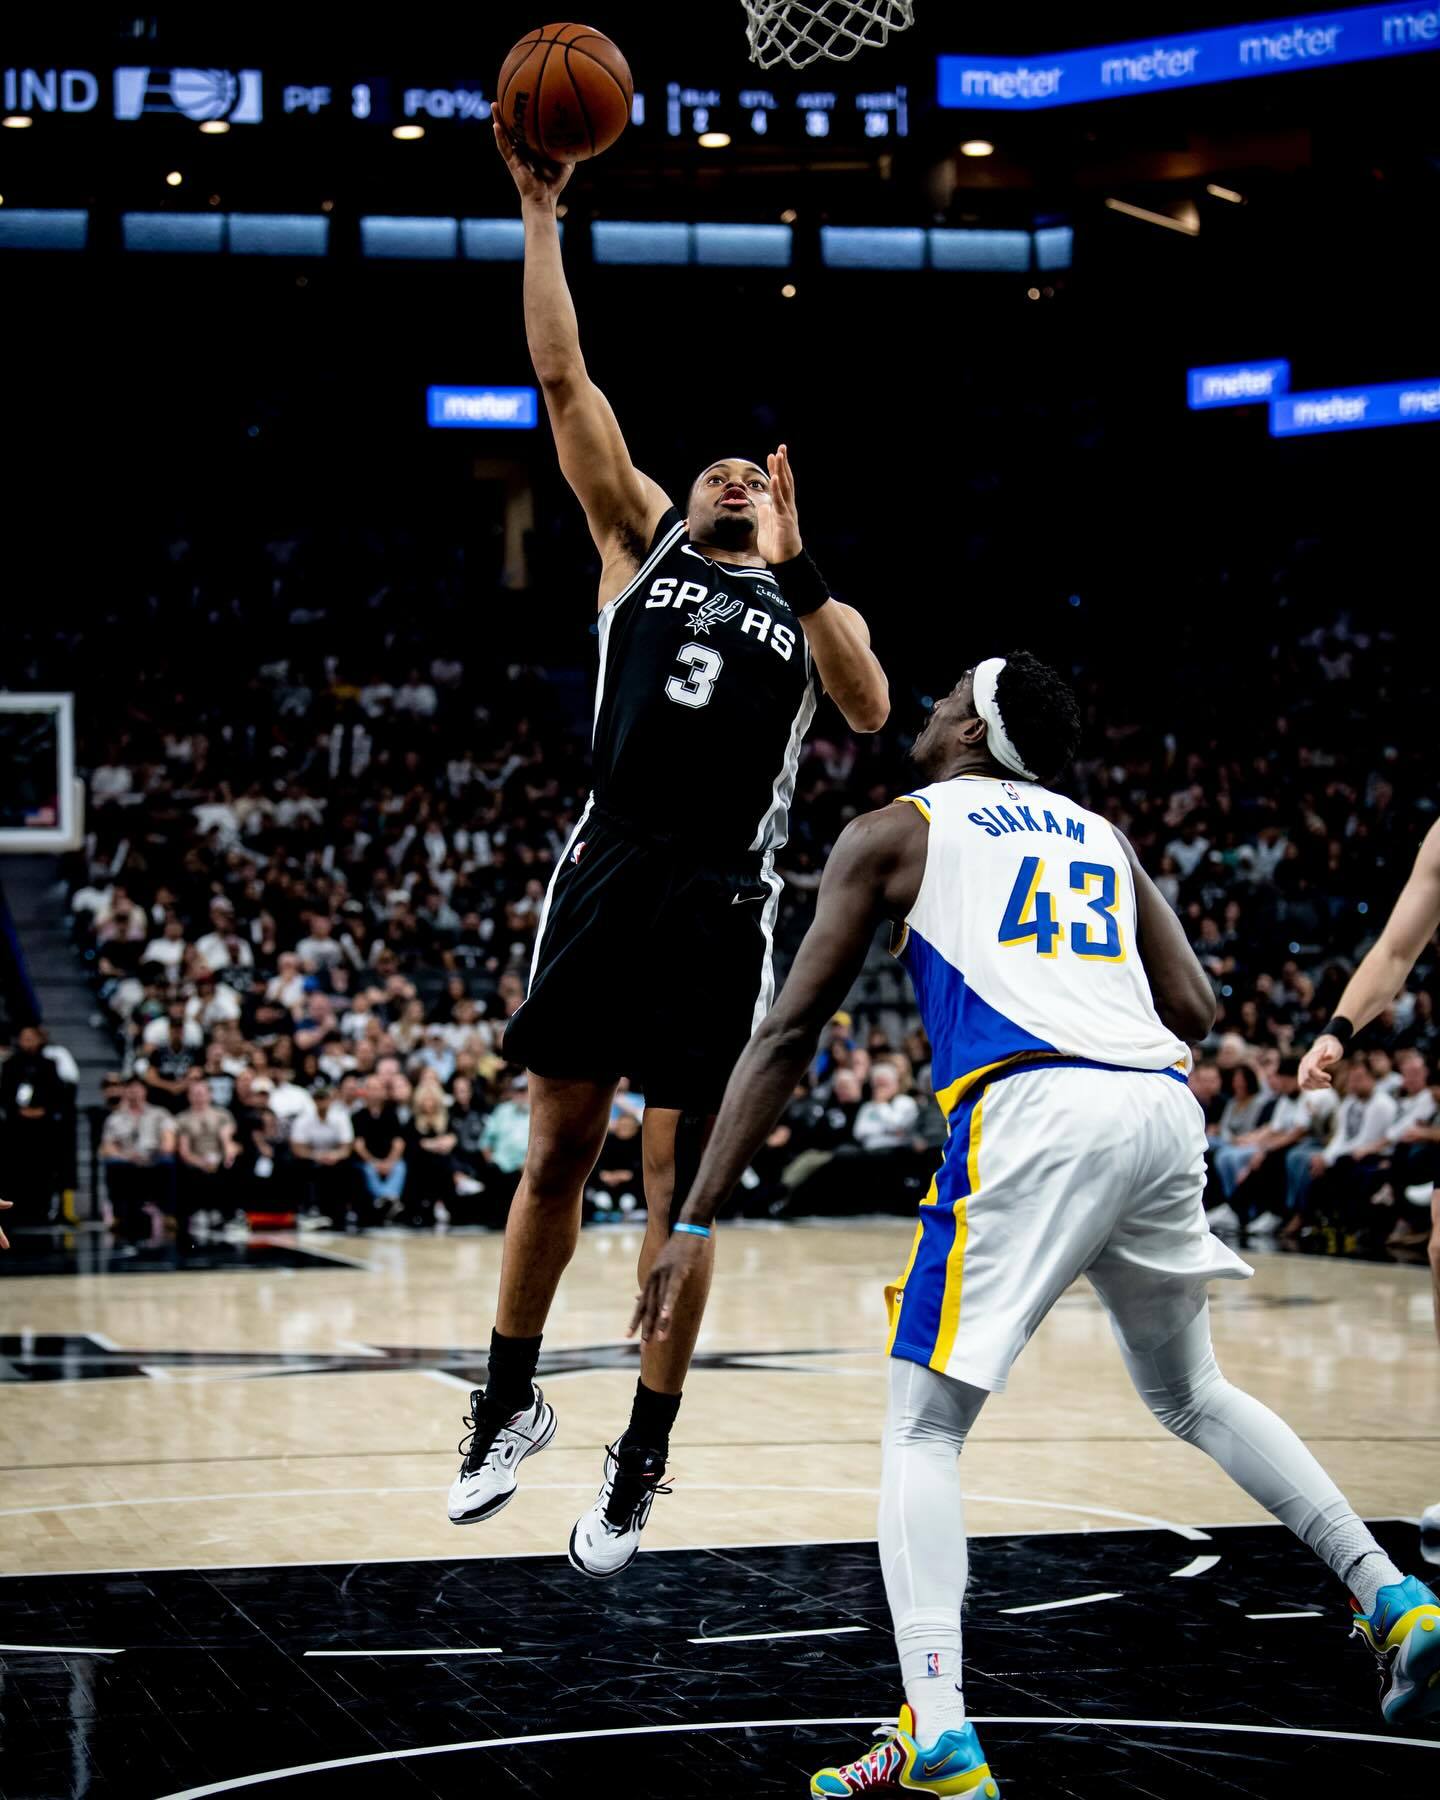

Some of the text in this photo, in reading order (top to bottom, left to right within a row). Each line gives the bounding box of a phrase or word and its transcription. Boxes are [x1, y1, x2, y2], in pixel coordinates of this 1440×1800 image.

[962, 13, 1440, 99] meter meter meter me
[4, 68, 98, 112] IND
[283, 85, 331, 113] PF
[1203, 369, 1274, 400] meter
[1294, 396, 1368, 425] meter
[665, 641, 724, 709] 3
[967, 805, 1086, 845] SIAKAM
[998, 856, 1127, 964] 43
